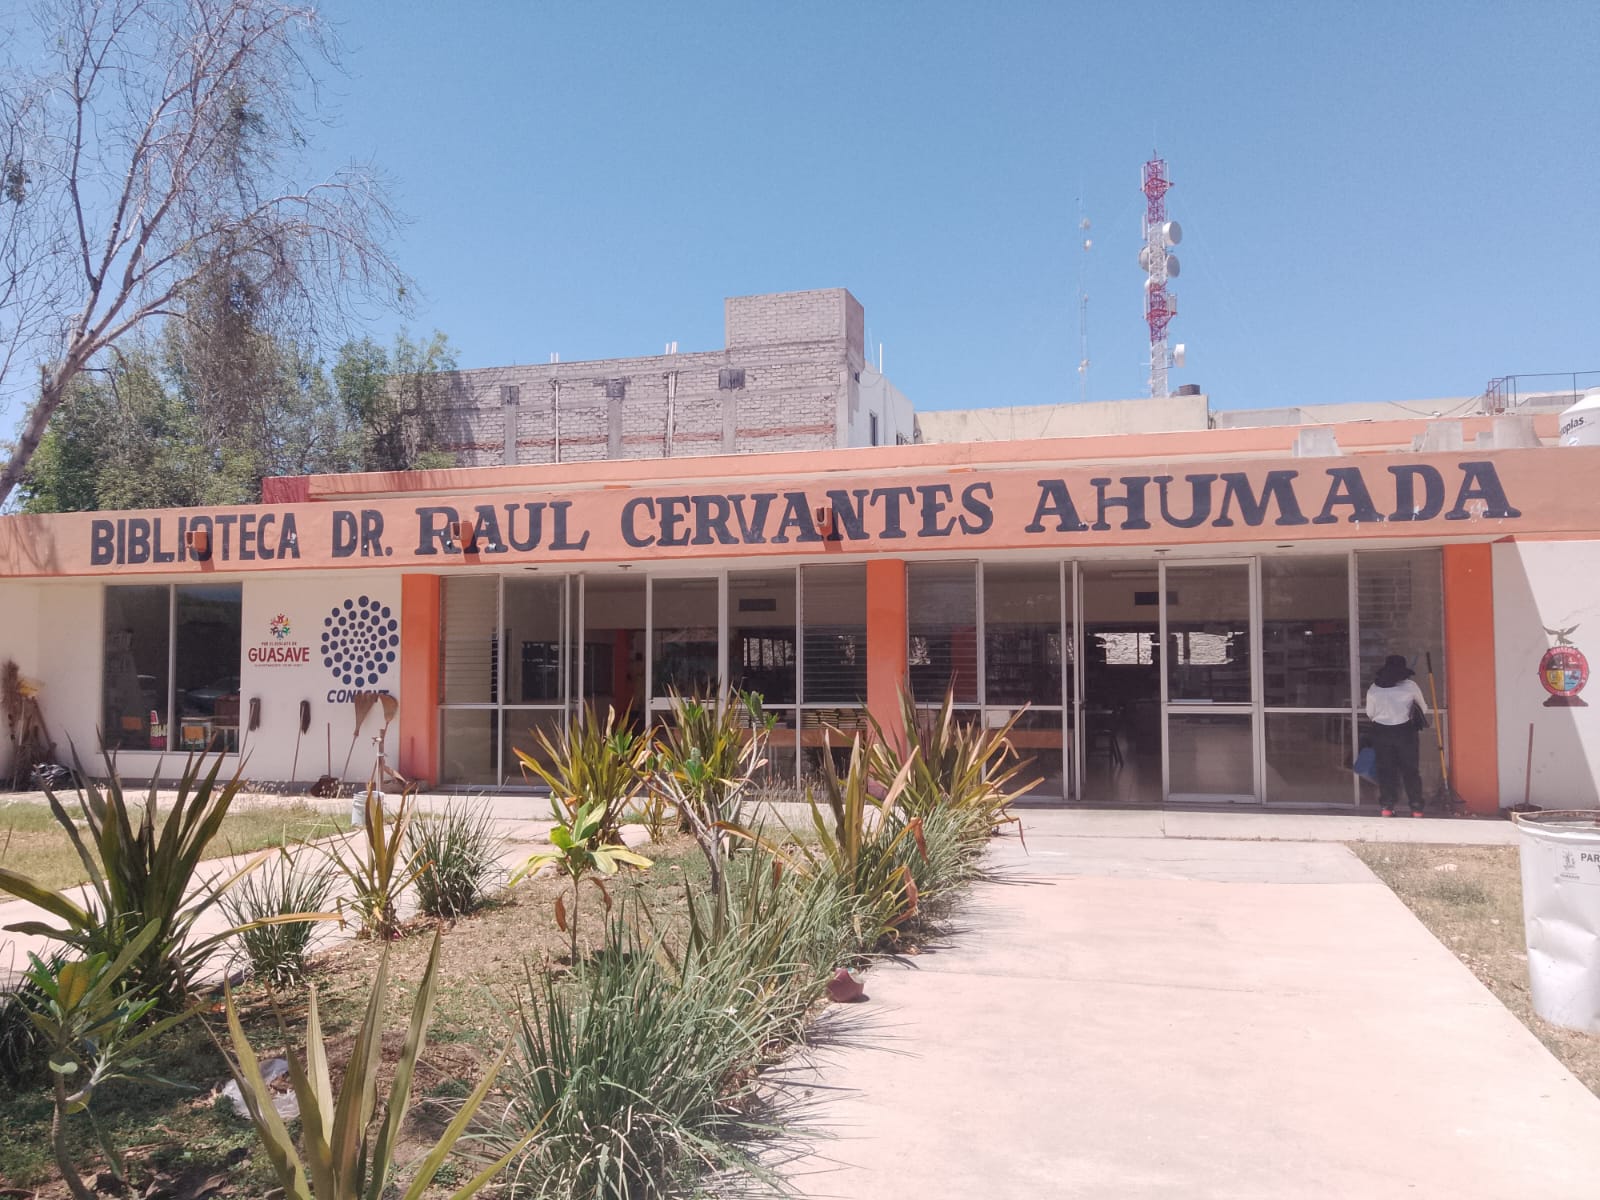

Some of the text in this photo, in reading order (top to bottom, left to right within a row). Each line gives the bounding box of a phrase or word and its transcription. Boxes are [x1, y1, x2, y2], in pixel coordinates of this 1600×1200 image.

[91, 461, 1522, 565] BIBLIOTECA DR. RAUL CERVANTES AHUMADA
[248, 647, 310, 663] GUASAVE
